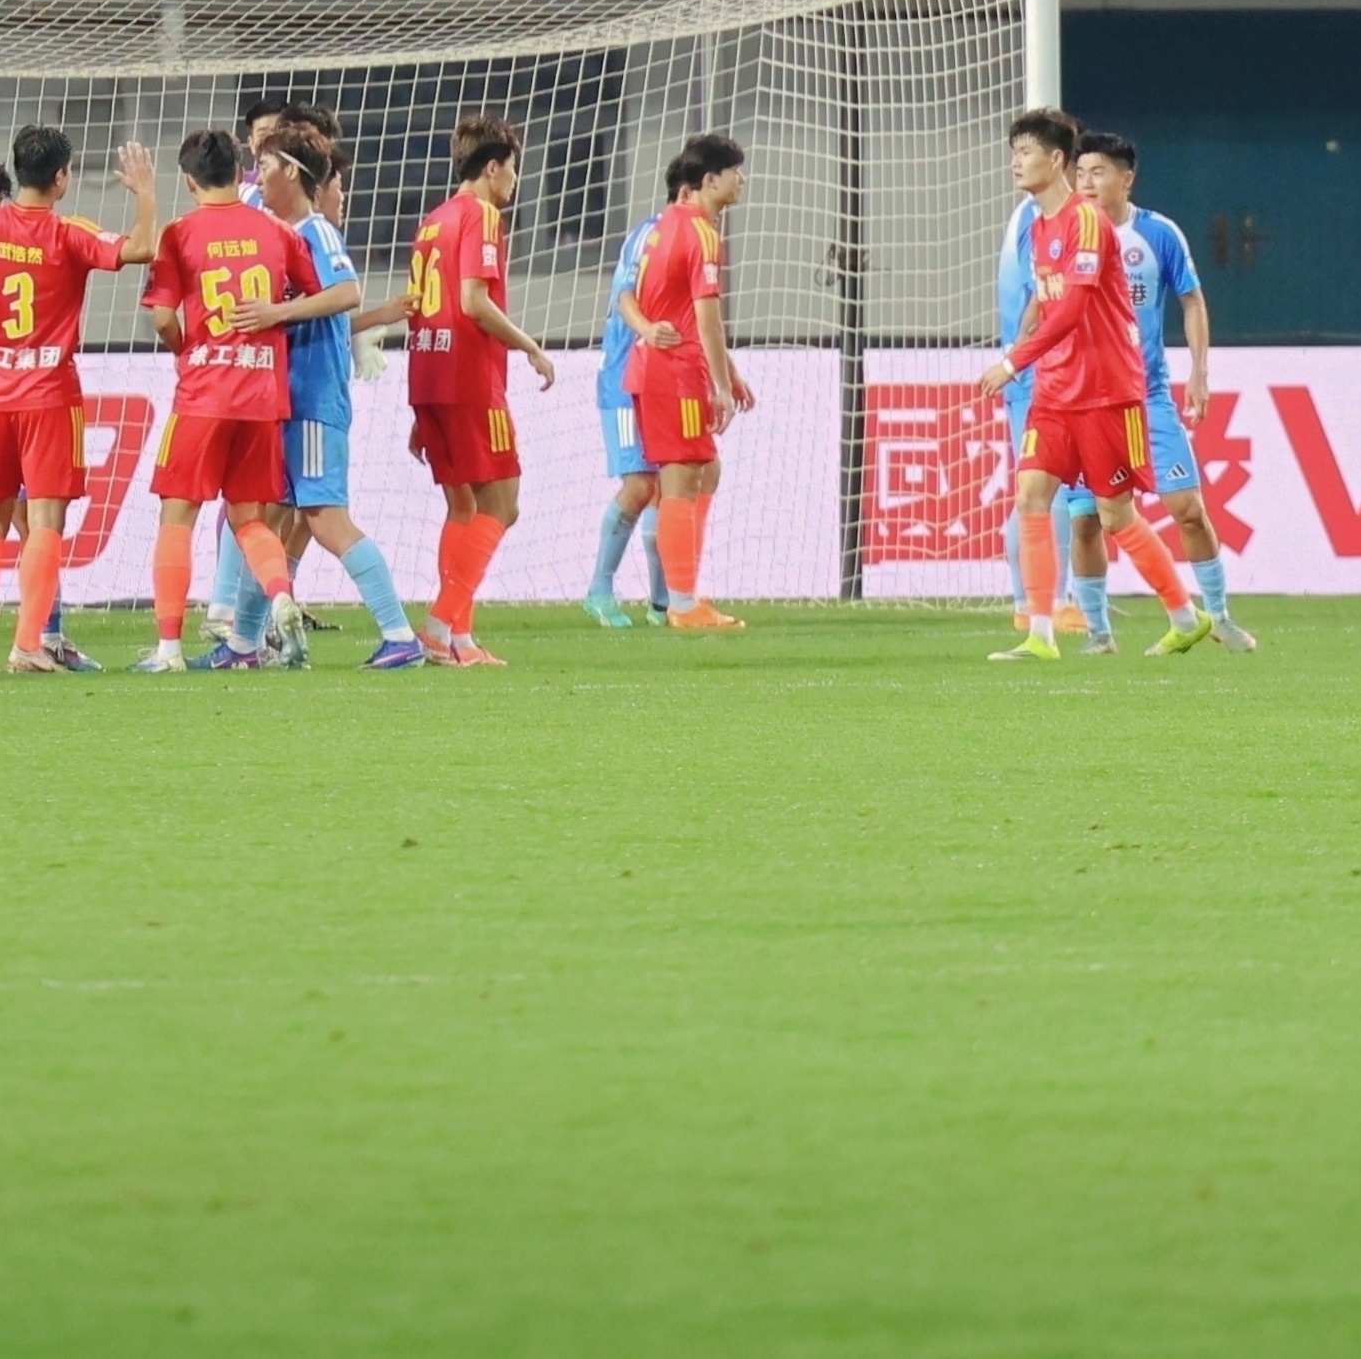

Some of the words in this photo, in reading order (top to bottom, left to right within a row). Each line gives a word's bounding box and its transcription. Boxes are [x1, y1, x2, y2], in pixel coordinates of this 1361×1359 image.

[1, 271, 36, 340] 3
[187, 343, 275, 370] 徐工集团
